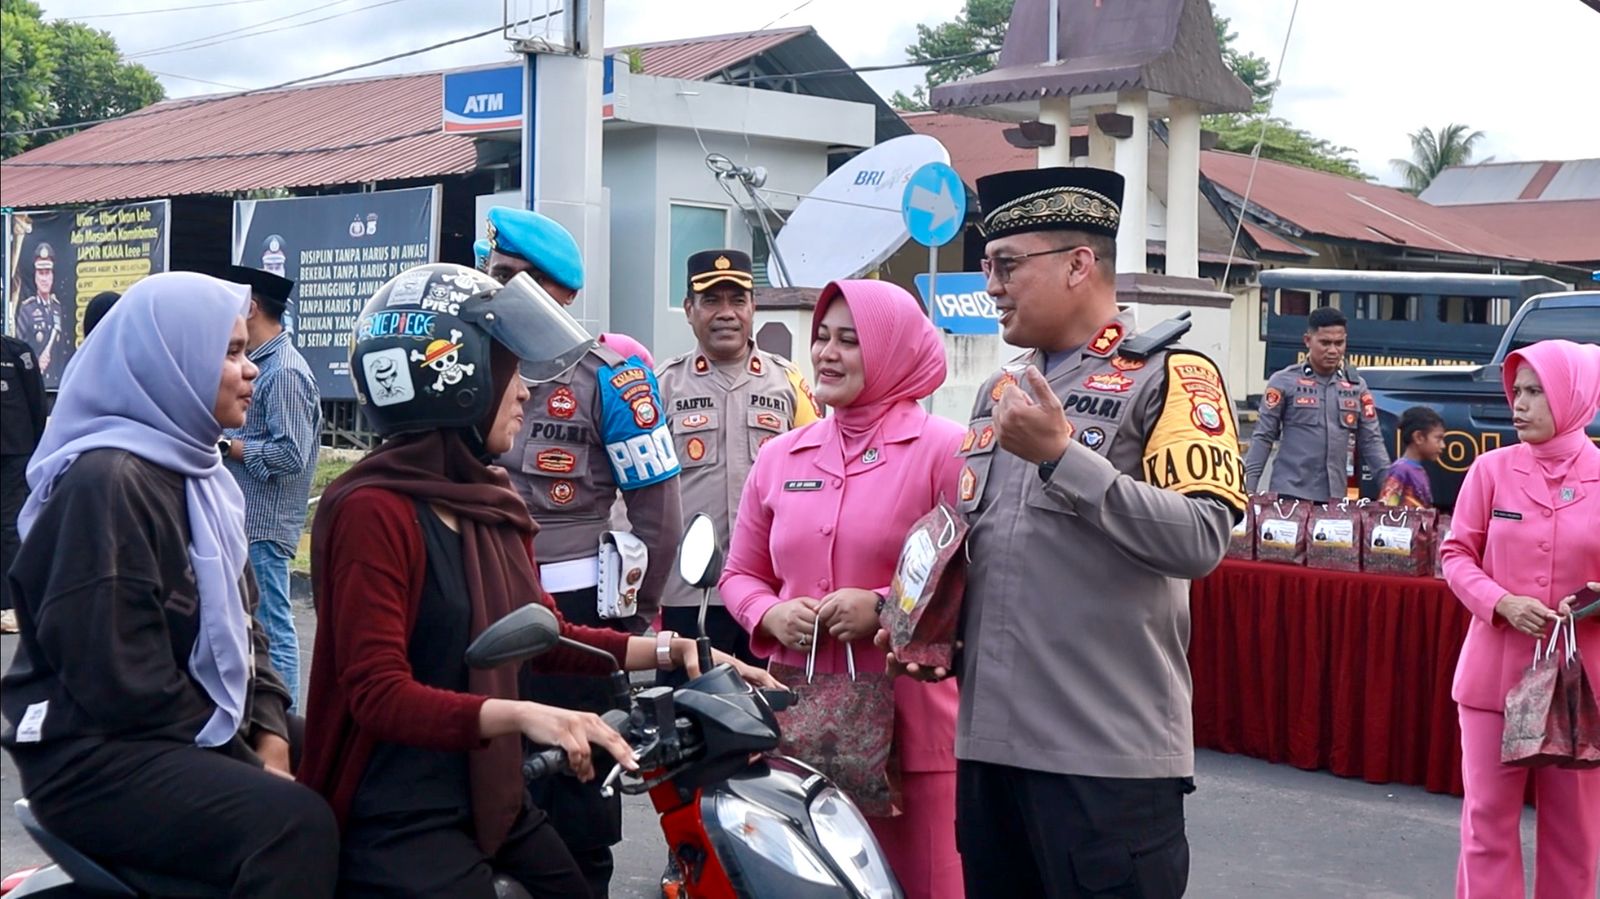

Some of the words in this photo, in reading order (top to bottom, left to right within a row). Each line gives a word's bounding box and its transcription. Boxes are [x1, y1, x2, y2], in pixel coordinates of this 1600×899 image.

[464, 93, 503, 114] ATM
[854, 171, 885, 185] BRI
[77, 246, 101, 260] LAPOR
[102, 244, 125, 259] KAKA
[300, 249, 333, 265] DISIPLIN
[334, 248, 361, 263] TANPA
[362, 246, 389, 262] HARUS
[391, 245, 399, 260] DI
[401, 243, 428, 259] AWASI
[300, 266, 331, 281] BEKERJA
[333, 265, 359, 279] TANPA
[360, 263, 387, 278] HARUS
[389, 262, 397, 277] DI
[300, 282, 356, 298] BERTANGGUNG
[299, 299, 323, 314] TANPA
[324, 299, 351, 313] HARUS
[352, 299, 361, 312] DI
[298, 317, 333, 331] LAKUKAN
[389, 312, 437, 335] PIECE
[297, 333, 306, 348] DI
[307, 332, 333, 347] SETIAP
[676, 397, 714, 411] SAIFUL
[751, 394, 785, 412] POLRI
[1063, 394, 1122, 419] POLRI
[531, 422, 589, 442] POLRI
